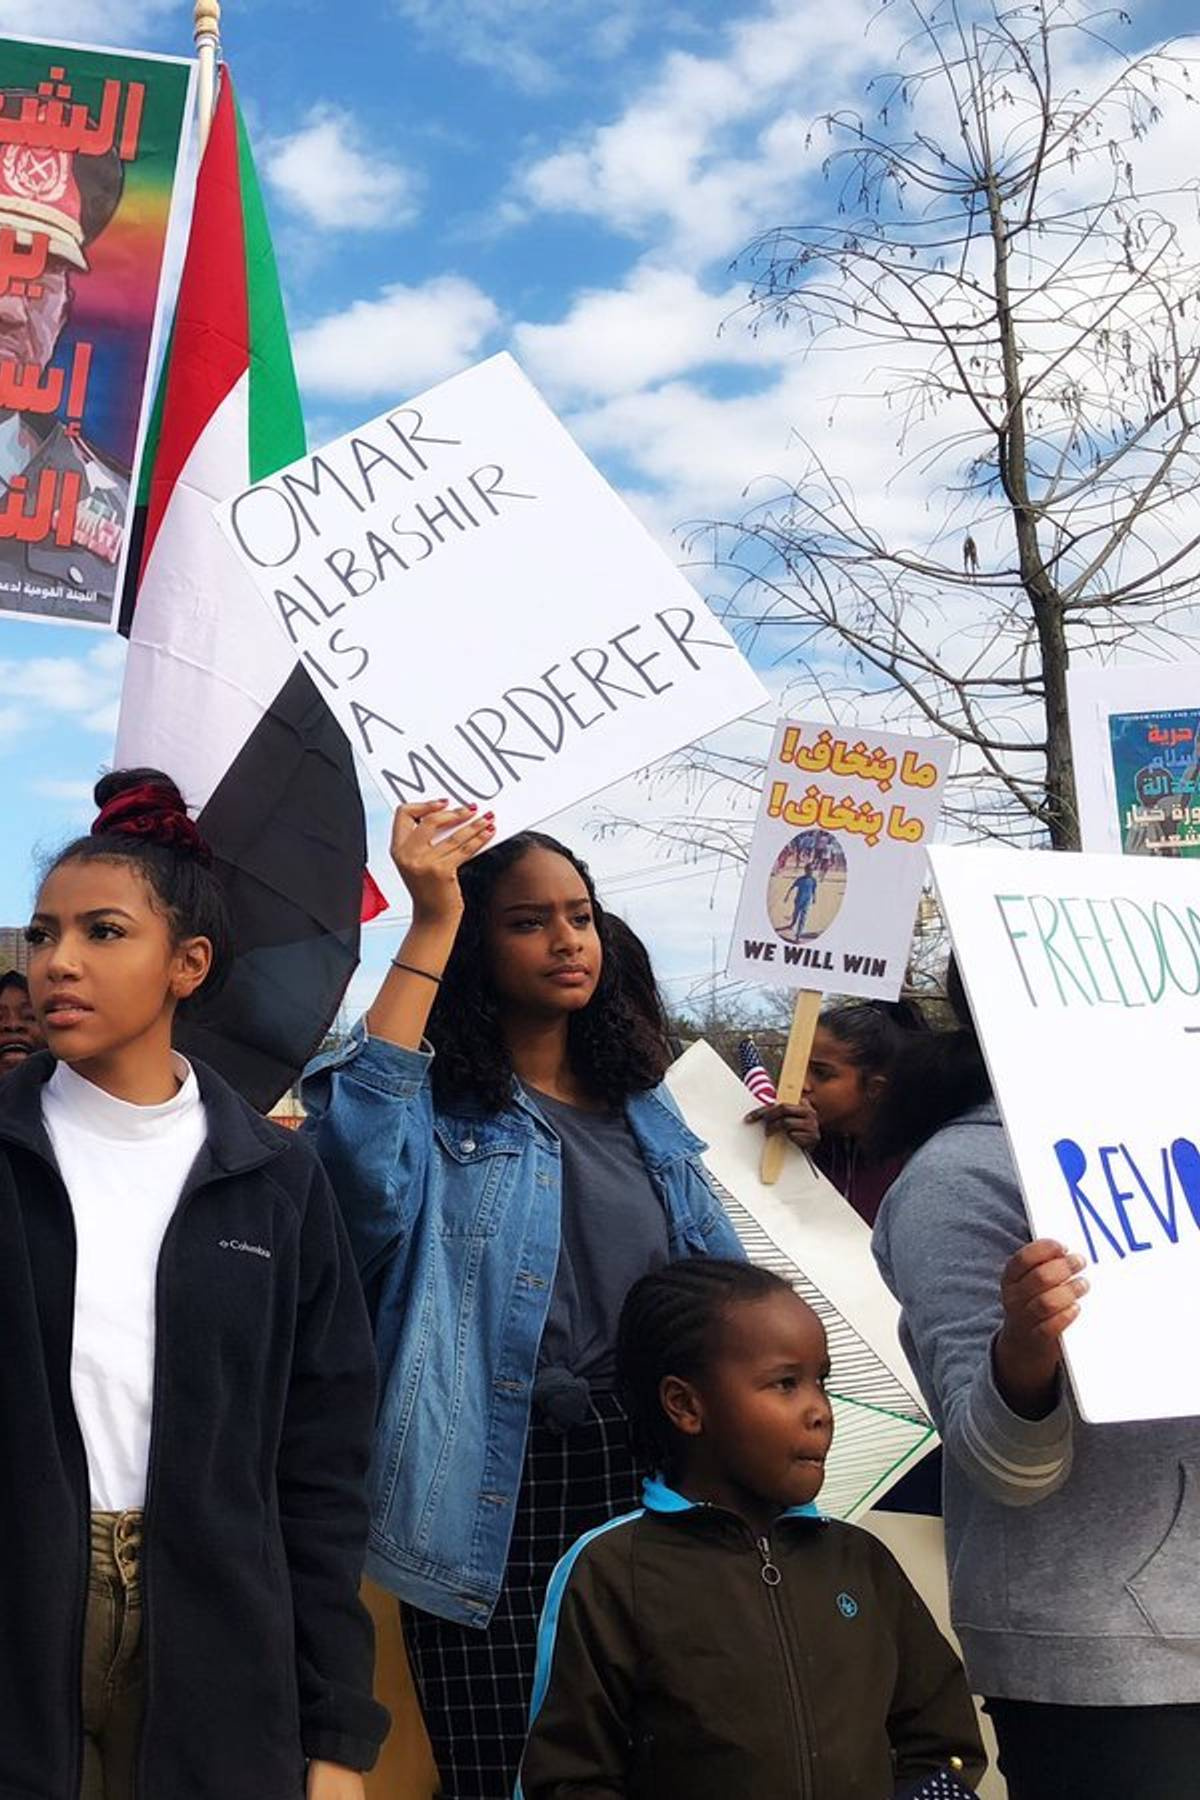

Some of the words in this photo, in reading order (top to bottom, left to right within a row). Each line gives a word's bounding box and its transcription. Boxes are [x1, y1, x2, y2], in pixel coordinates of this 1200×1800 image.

[231, 408, 461, 567] OMAR
[303, 628, 369, 690] IS
[350, 701, 405, 754] A
[381, 607, 734, 808] MURDERER
[900, 750, 937, 788] ما
[887, 805, 924, 842] ما
[743, 940, 777, 962] WE
[784, 946, 834, 971] WILL
[843, 954, 887, 978] WIN
